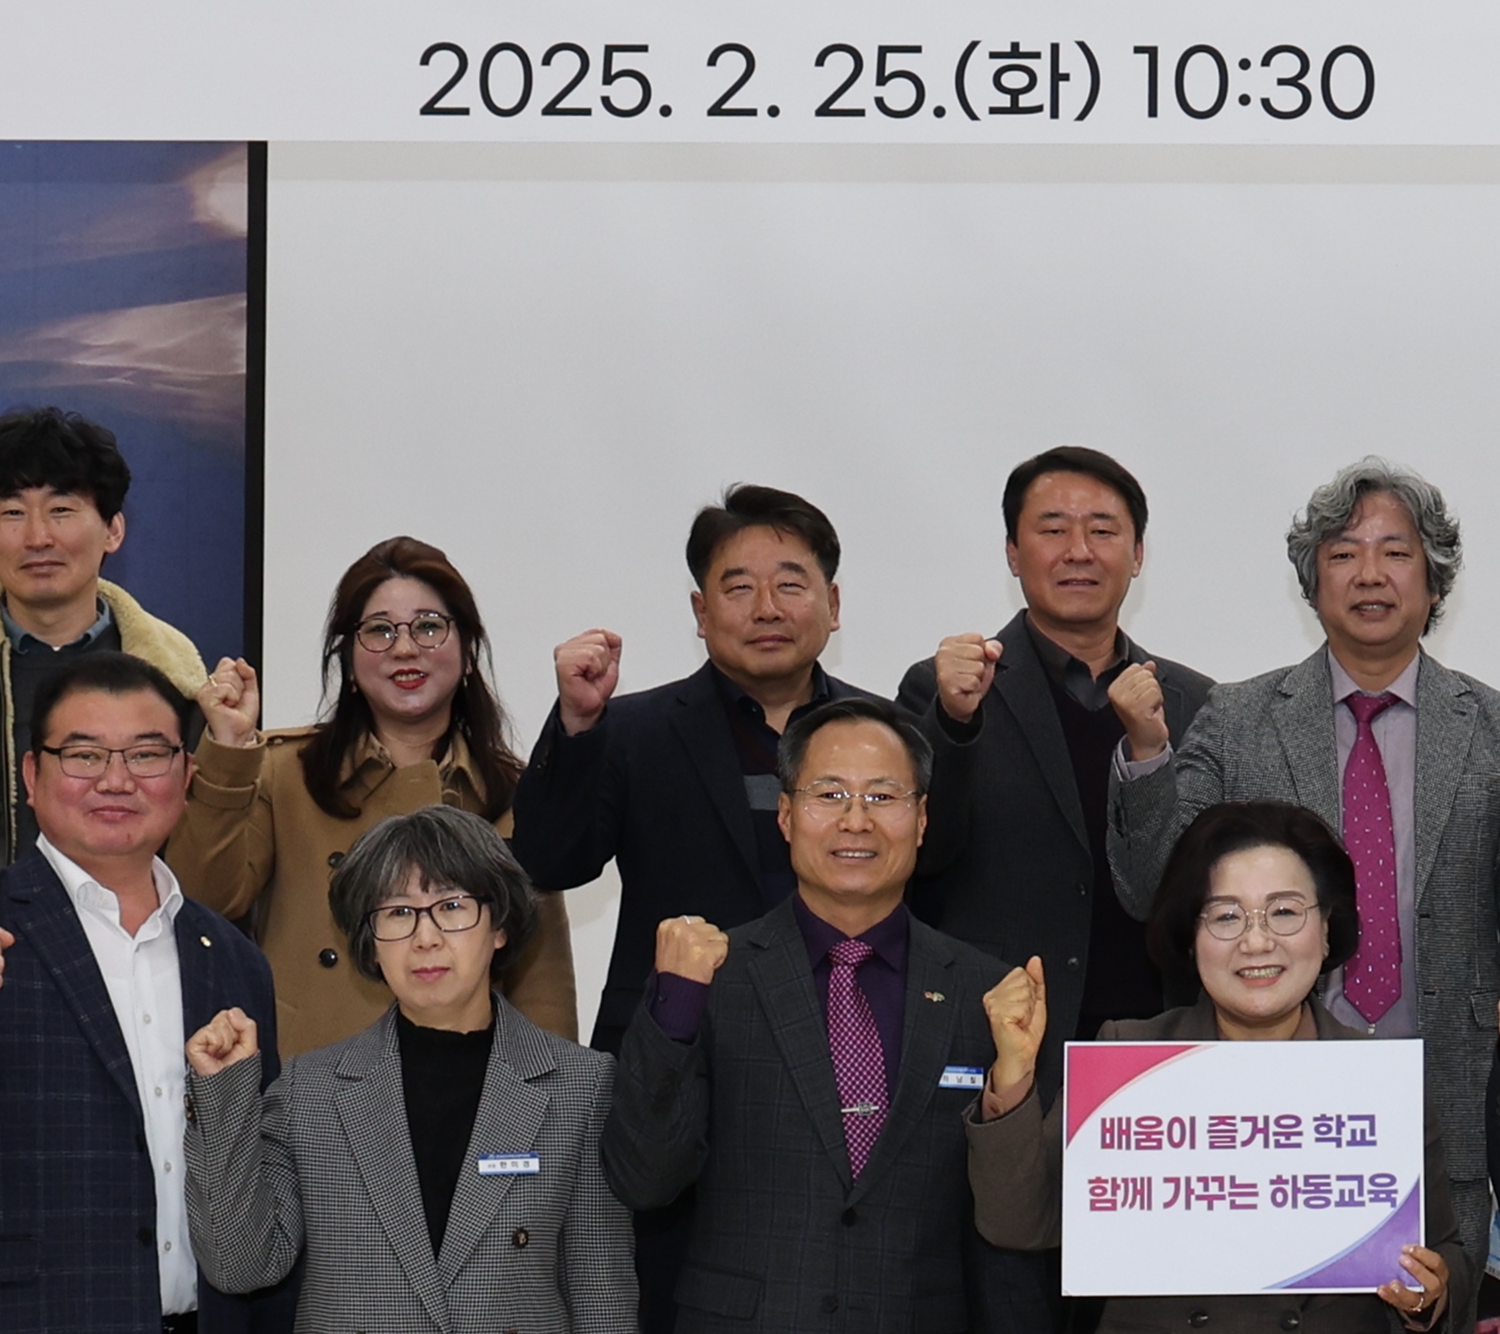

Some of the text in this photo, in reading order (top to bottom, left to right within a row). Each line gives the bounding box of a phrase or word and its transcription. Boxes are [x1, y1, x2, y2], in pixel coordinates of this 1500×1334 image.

[420, 42, 672, 120] 2025.
[707, 42, 780, 119] 2.
[815, 40, 1100, 122] 25.(화)
[1133, 43, 1375, 121] 10:30
[1100, 1113, 1378, 1151] 배움이 즐거운 학교
[1087, 1172, 1399, 1212] 함께 가꾸는 하동교육
